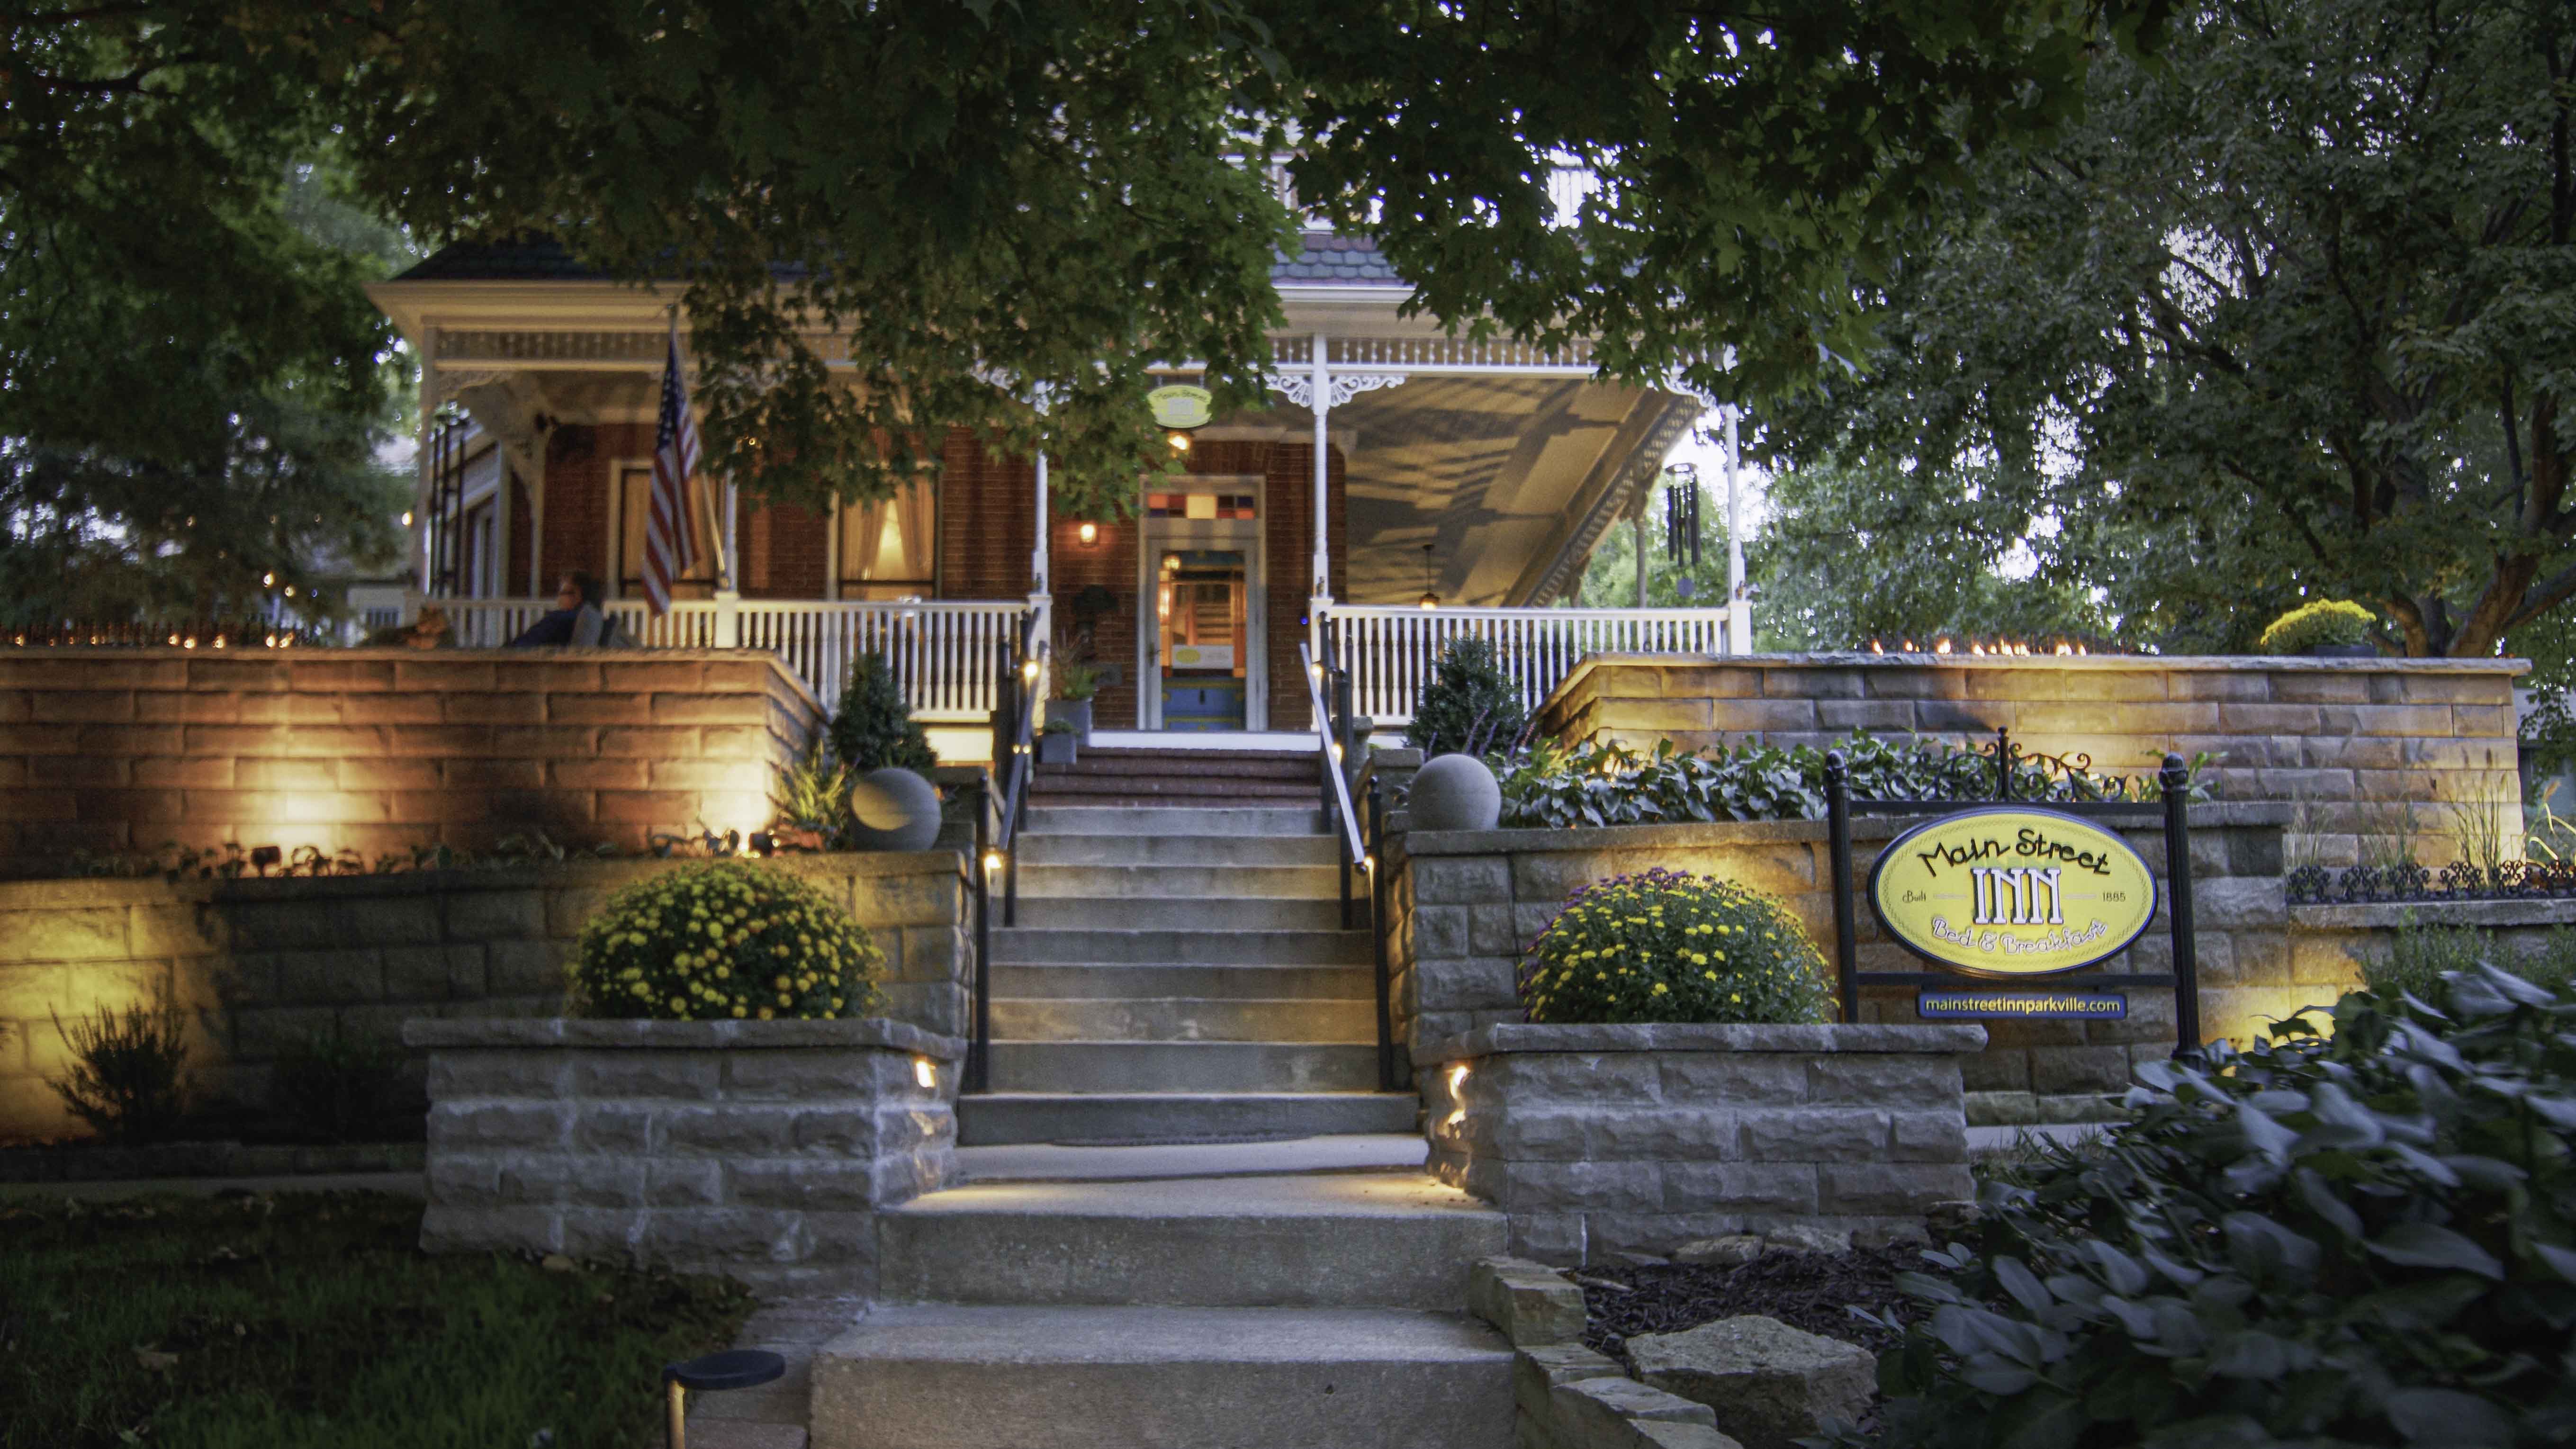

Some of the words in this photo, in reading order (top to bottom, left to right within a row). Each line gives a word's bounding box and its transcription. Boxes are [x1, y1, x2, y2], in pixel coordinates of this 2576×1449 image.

[1918, 837, 2010, 877] Main
[2016, 828, 2110, 874] Street
[1971, 868, 2064, 925] INN
[1933, 917, 1975, 947] Bed
[1979, 930, 1998, 953] &
[2001, 919, 2107, 954] Breakfast
[1926, 997, 2120, 1015] mainstreetinnparkville.com
